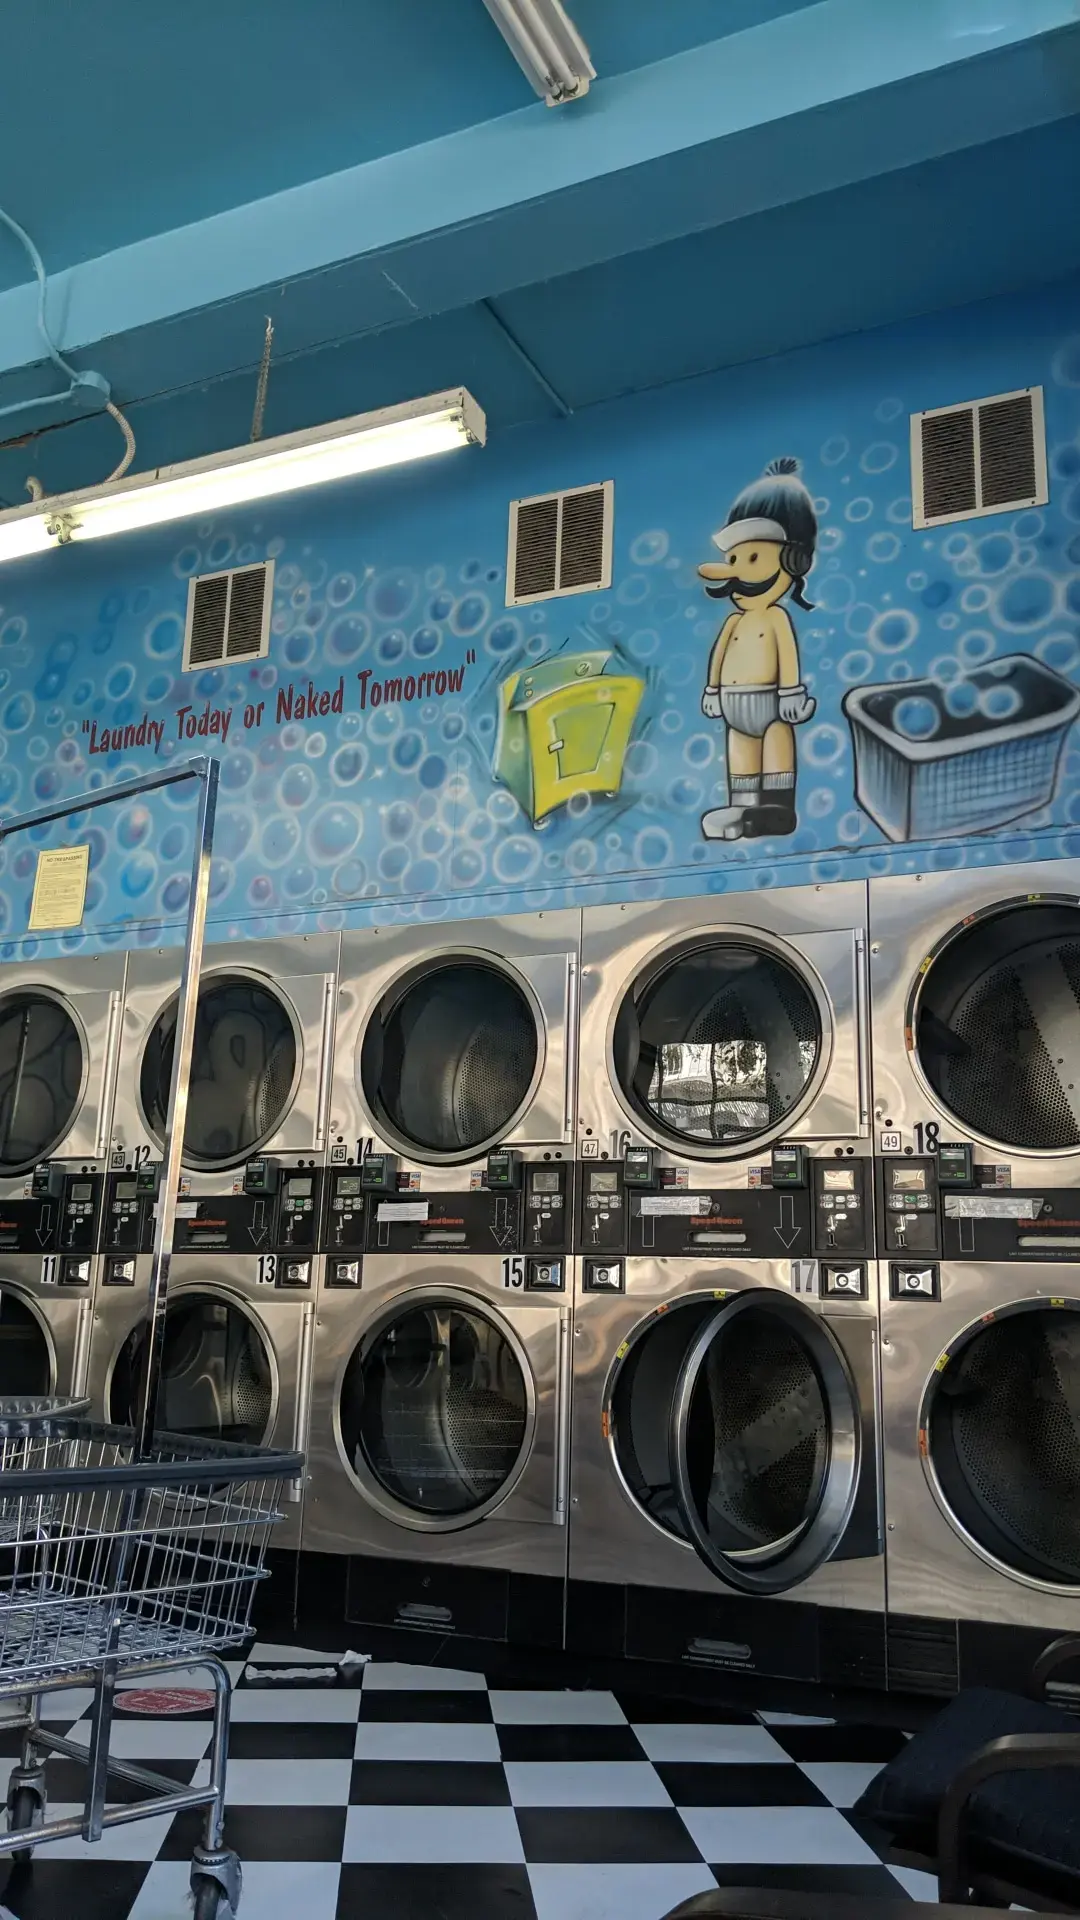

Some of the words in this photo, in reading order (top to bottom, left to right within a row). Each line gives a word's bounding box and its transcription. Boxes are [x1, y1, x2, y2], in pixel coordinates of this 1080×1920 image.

[82, 712, 165, 754] "Laundry
[176, 701, 232, 743] Today
[244, 702, 264, 729] or
[276, 676, 344, 724] Naked
[357, 649, 476, 710] Tomorrow"
[584, 1143, 596, 1154] 47
[610, 1129, 632, 1159] 16
[884, 1136, 898, 1147] 49
[914, 1121, 940, 1154] 18
[333, 1149, 344, 1159] 45
[43, 1256, 57, 1282] 11
[258, 1255, 276, 1283] 13
[502, 1258, 523, 1287] 15
[791, 1260, 817, 1293] 17
